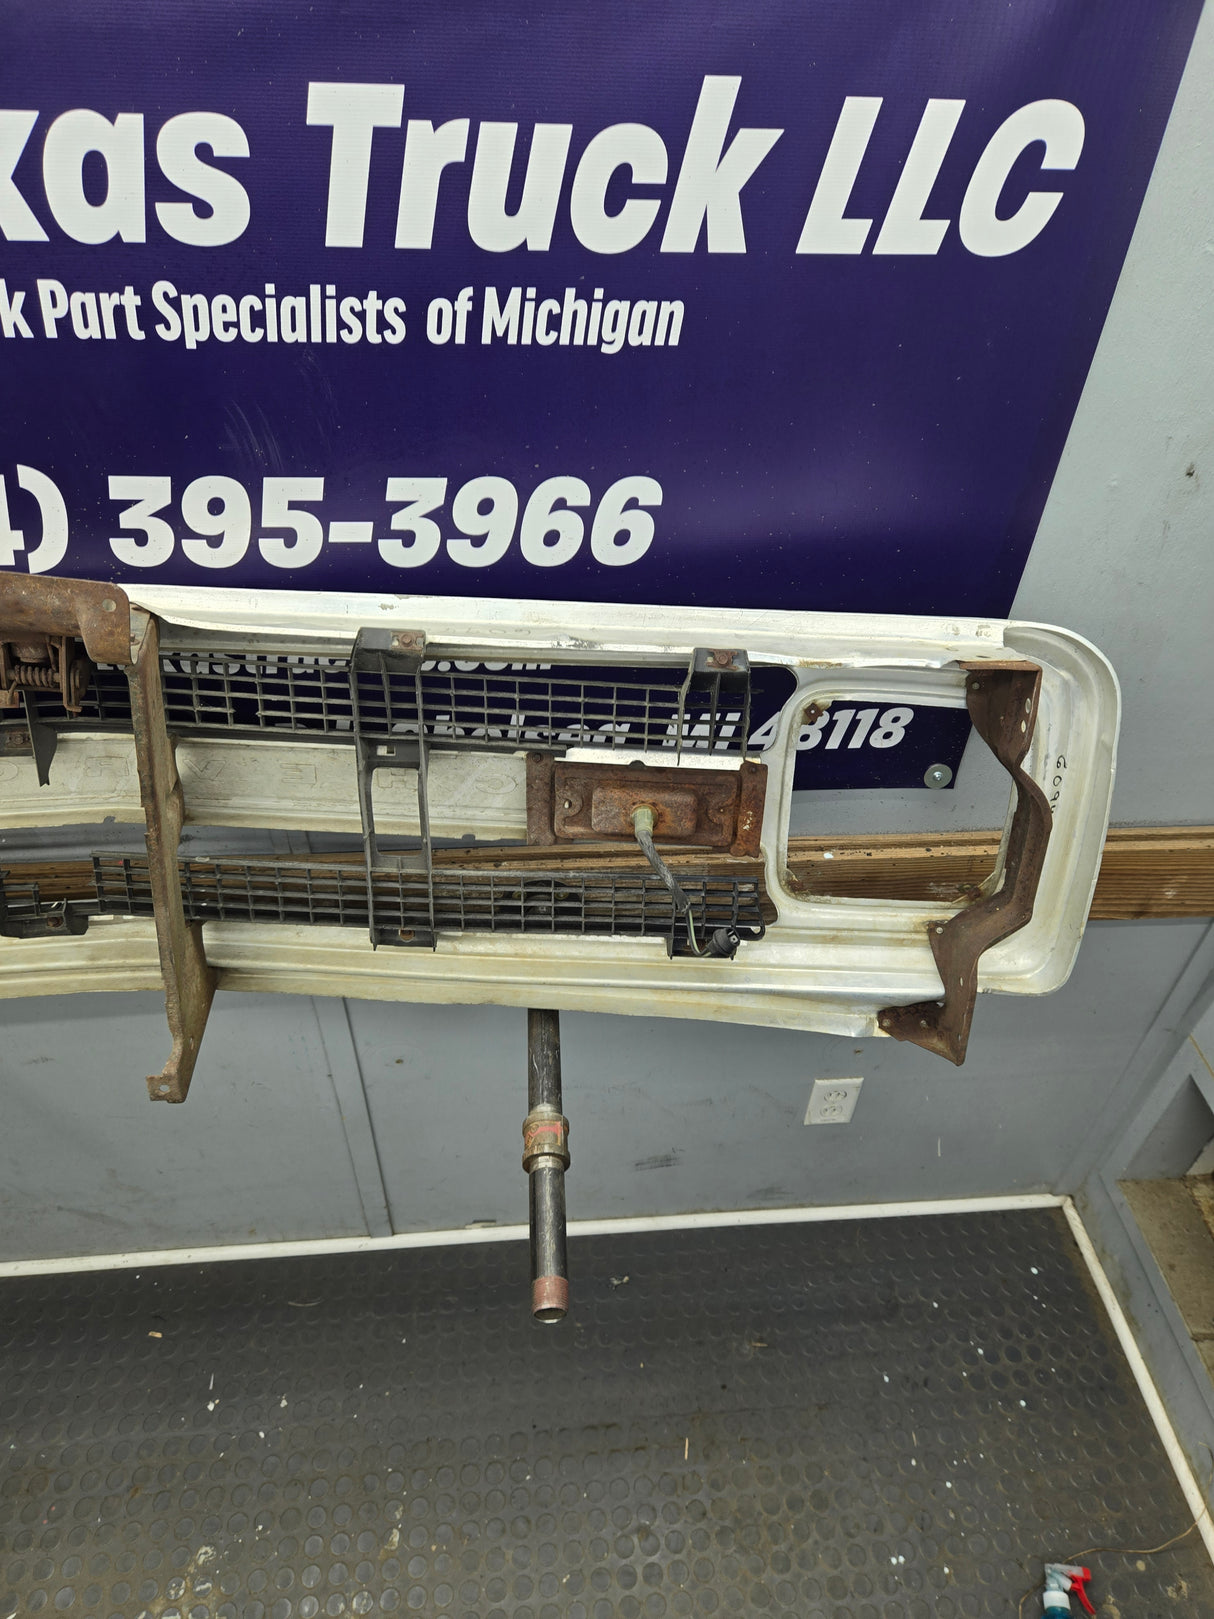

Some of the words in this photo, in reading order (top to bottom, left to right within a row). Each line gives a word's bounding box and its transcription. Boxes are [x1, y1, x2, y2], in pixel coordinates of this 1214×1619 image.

[306, 75, 784, 254] Truck
[796, 96, 1085, 257] LLC
[0, 279, 34, 338] k
[37, 279, 145, 340] Part
[152, 281, 406, 349] Specialists
[427, 287, 473, 344] of
[482, 287, 684, 354] Michigan
[108, 476, 662, 568] 395-3966
